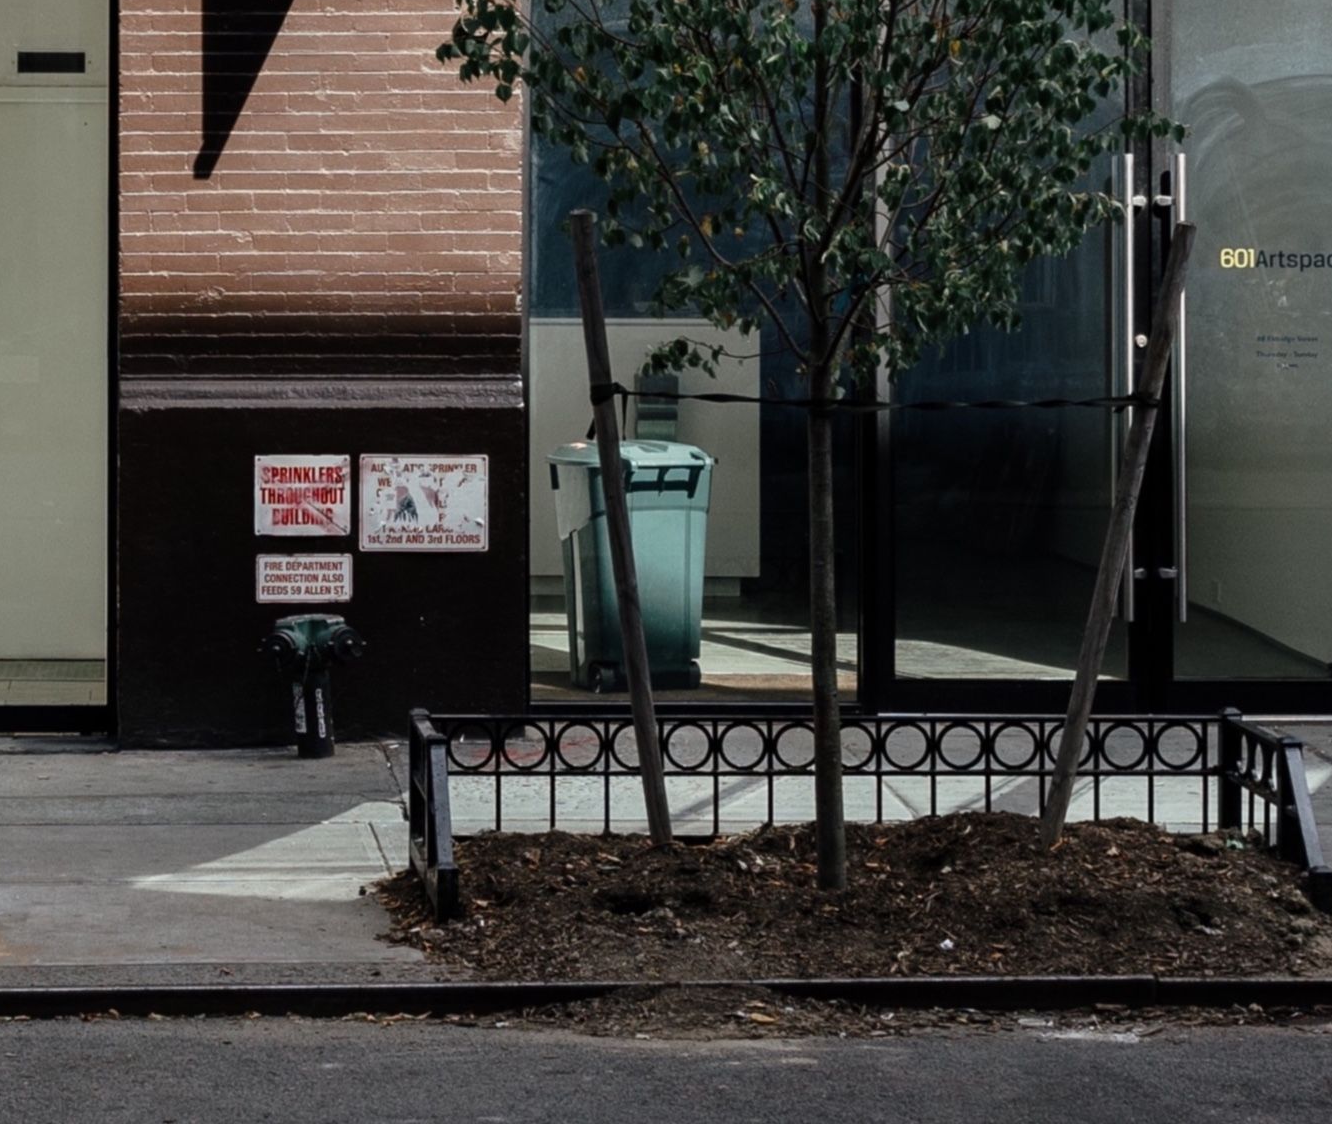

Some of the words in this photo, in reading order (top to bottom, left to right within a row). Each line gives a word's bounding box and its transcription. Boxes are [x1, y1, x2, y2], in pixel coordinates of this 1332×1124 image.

[262, 466, 344, 484] SPRINKLERS
[385, 534, 403, 544] 2nd
[405, 534, 425, 544] AND
[427, 534, 443, 544] 3rd
[445, 534, 481, 544] FLOORS
[264, 561, 283, 571] FIRE
[285, 561, 343, 571] DEPARTMENT
[264, 573, 319, 584] CONNECTION
[321, 573, 344, 584] ALSO
[261, 585, 289, 596] FEEDS
[304, 585, 332, 596] ALLEN
